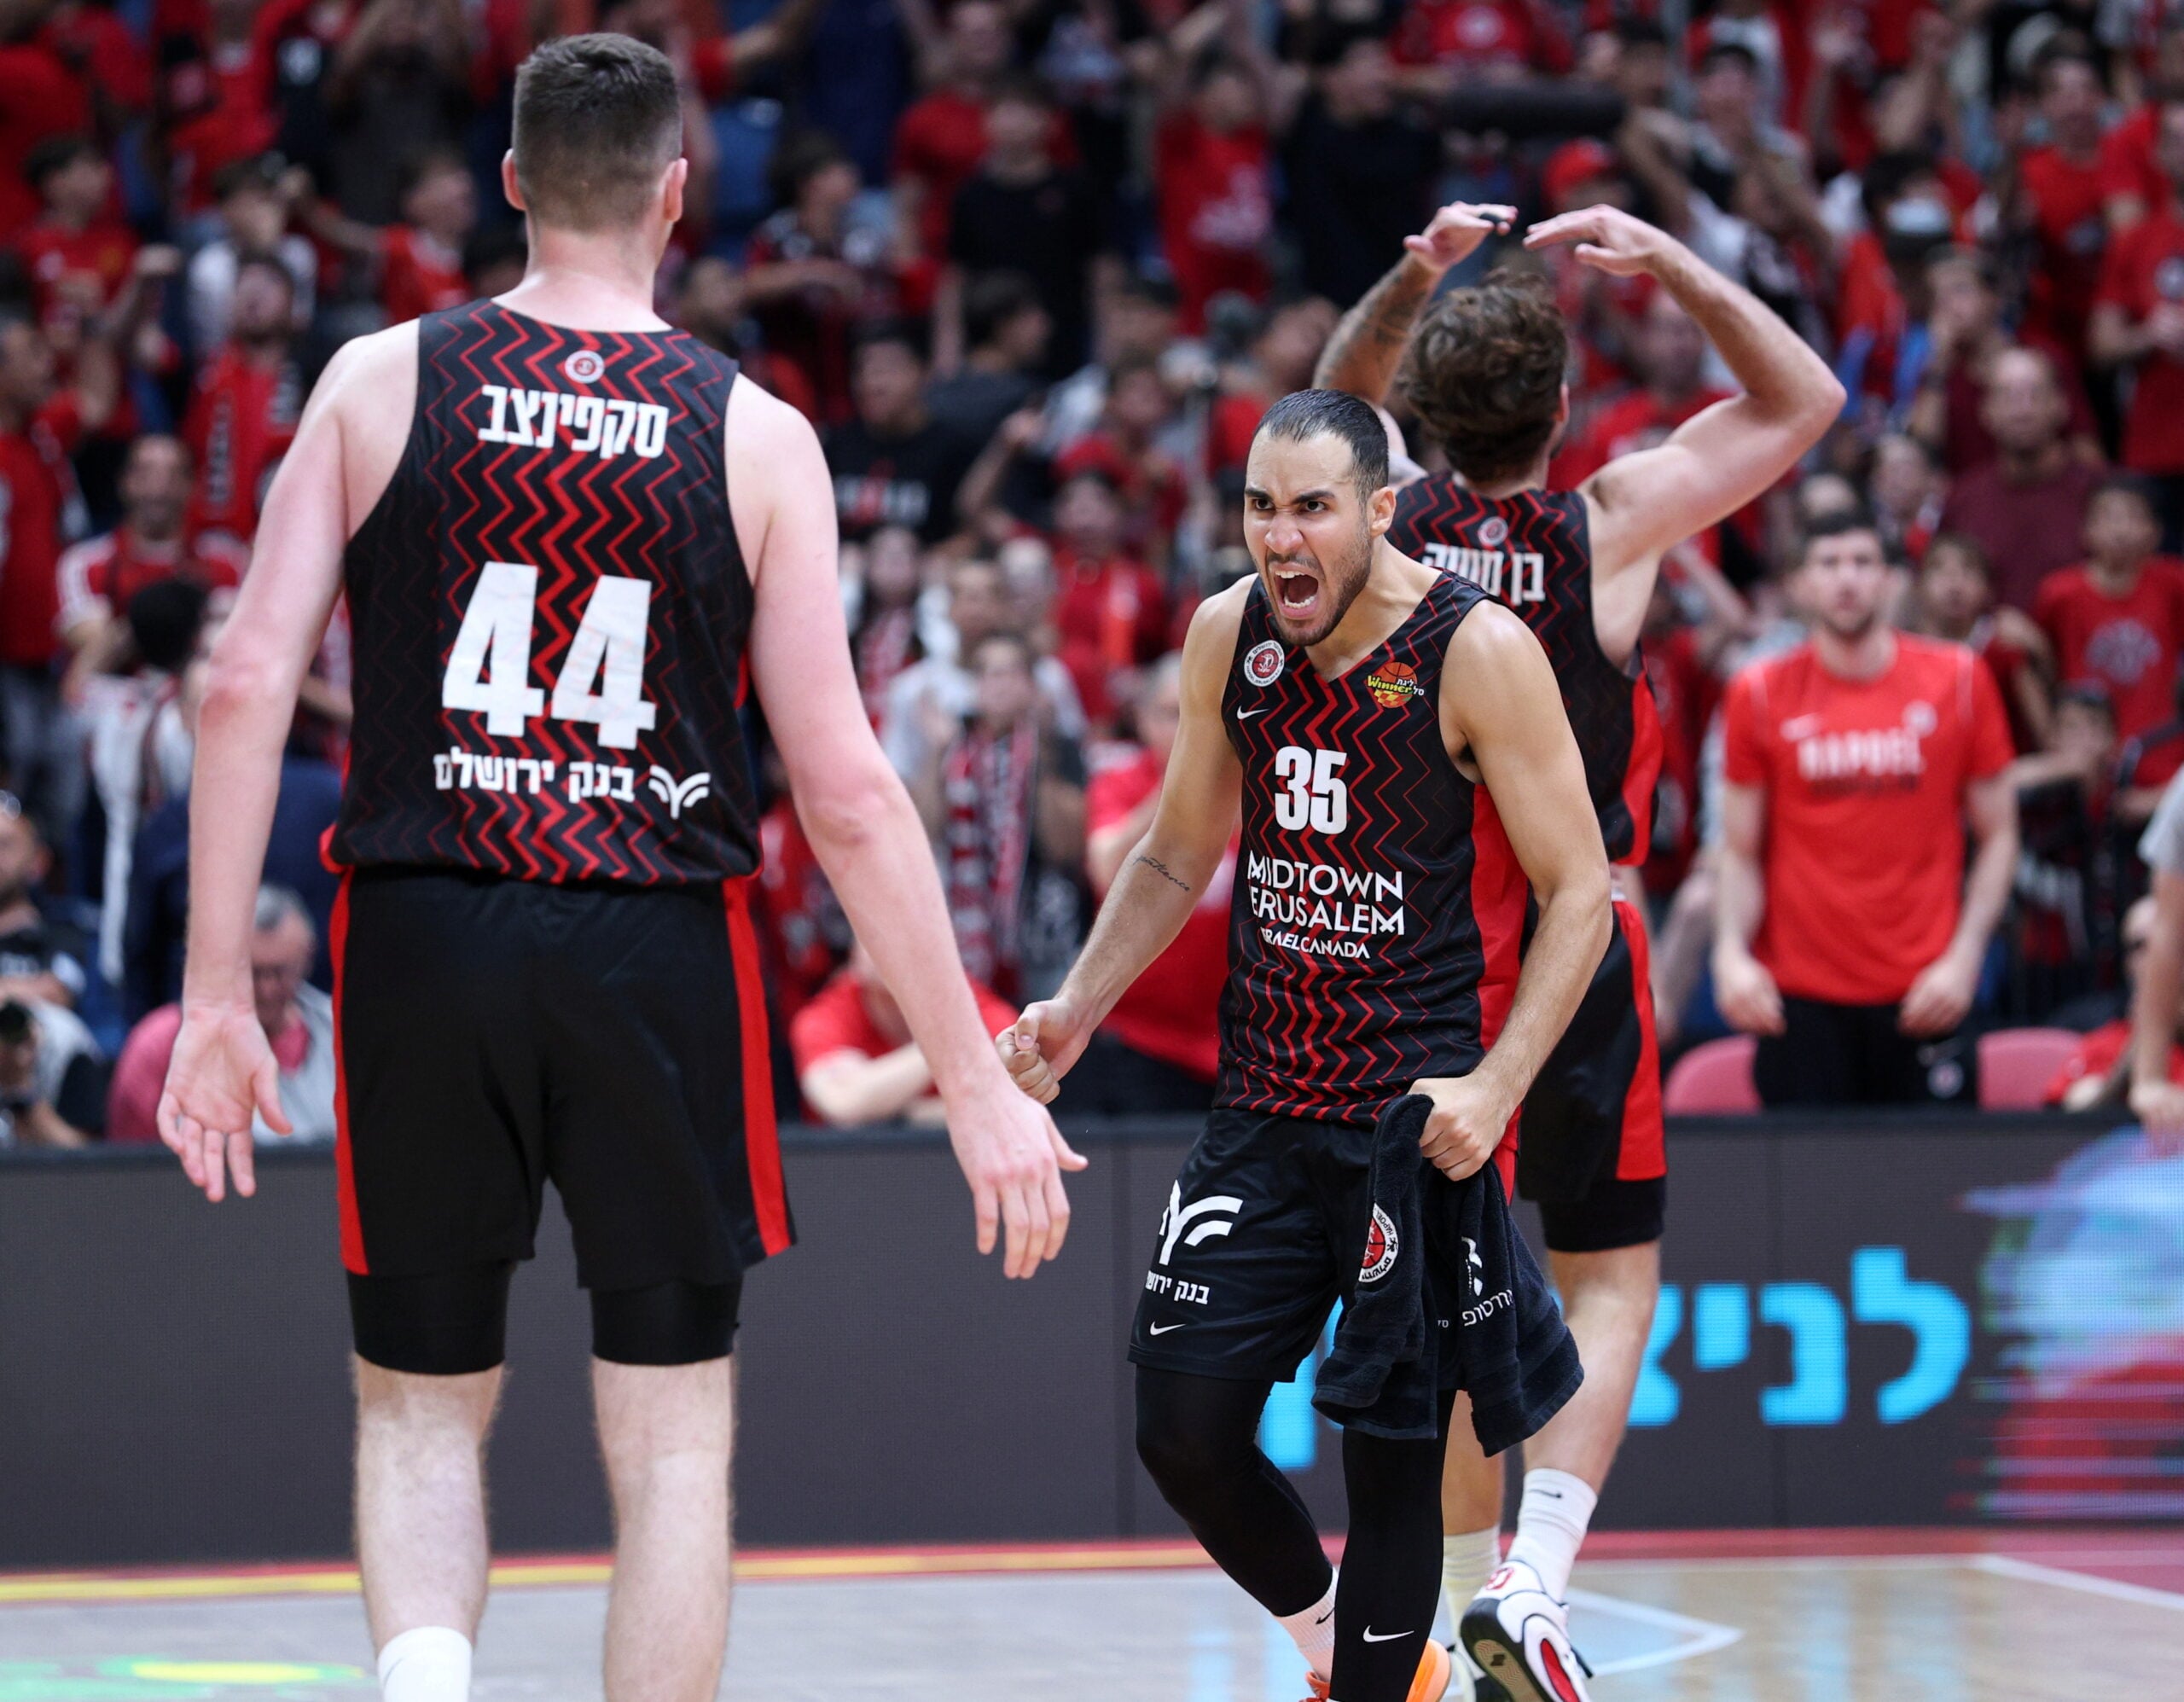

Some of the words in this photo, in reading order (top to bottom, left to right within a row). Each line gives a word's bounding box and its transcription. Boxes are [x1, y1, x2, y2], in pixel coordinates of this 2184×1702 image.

[478, 384, 669, 459] סקפינצב
[1510, 552, 1545, 606] בן
[442, 561, 657, 750] 44
[1367, 675, 1412, 693] Winner
[1413, 686, 1425, 696] סל
[568, 761, 636, 804] בנק
[1275, 746, 1348, 834] 35
[1247, 850, 1403, 902] MIDTOWN
[1250, 886, 1405, 936] ERUSALEM
[1145, 1269, 1172, 1294] ירוש
[1174, 1281, 1210, 1304] בנק
